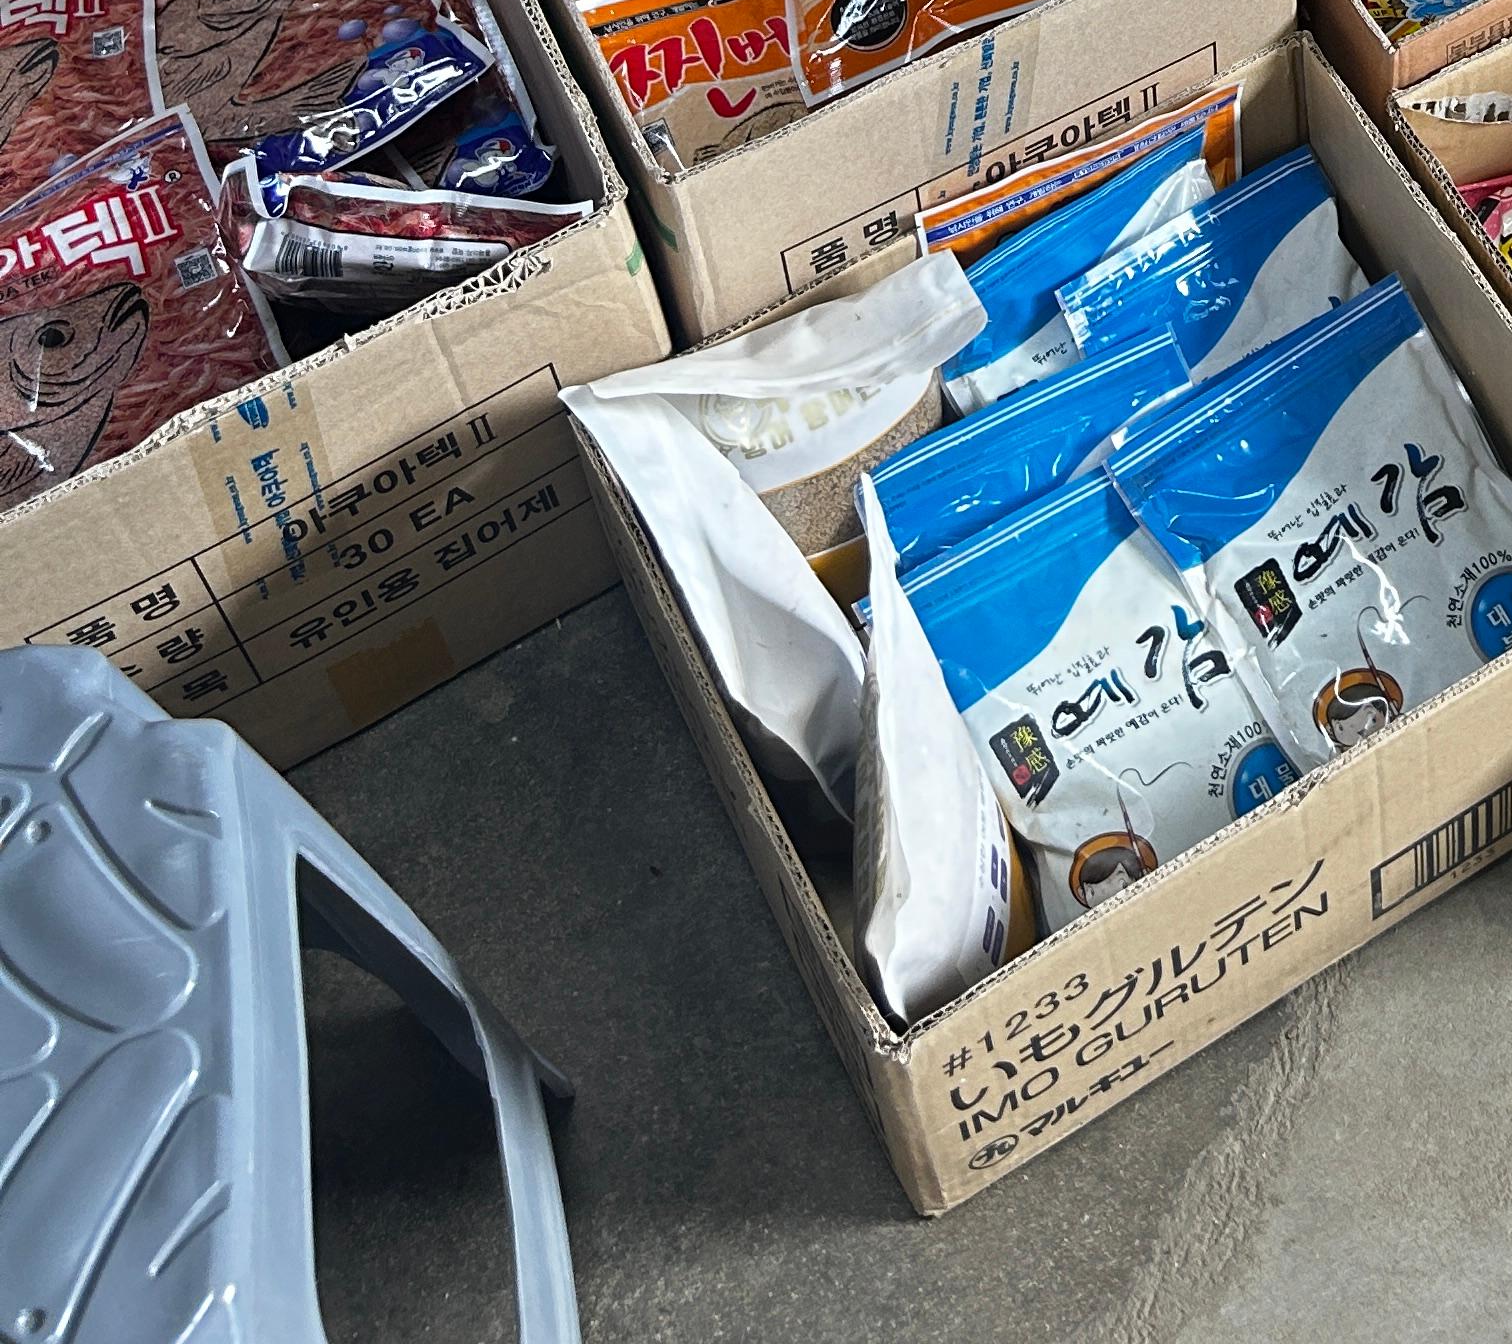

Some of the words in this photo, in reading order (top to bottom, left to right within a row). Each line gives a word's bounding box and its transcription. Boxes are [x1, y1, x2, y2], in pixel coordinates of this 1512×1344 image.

[983, 99, 1132, 185] 아쿠아텍
[280, 434, 467, 545] 아쿠아텍
[338, 528, 395, 572] 30
[410, 484, 477, 534] EA
[289, 566, 423, 649] 유인용
[433, 484, 562, 569] 집어제
[943, 972, 1092, 1080] #1233
[948, 856, 1327, 1112] いもグルテン
[955, 1070, 1059, 1143] IMO
[1075, 891, 1330, 1065] GURUTEN
[1020, 1039, 1176, 1140] マルキュー
